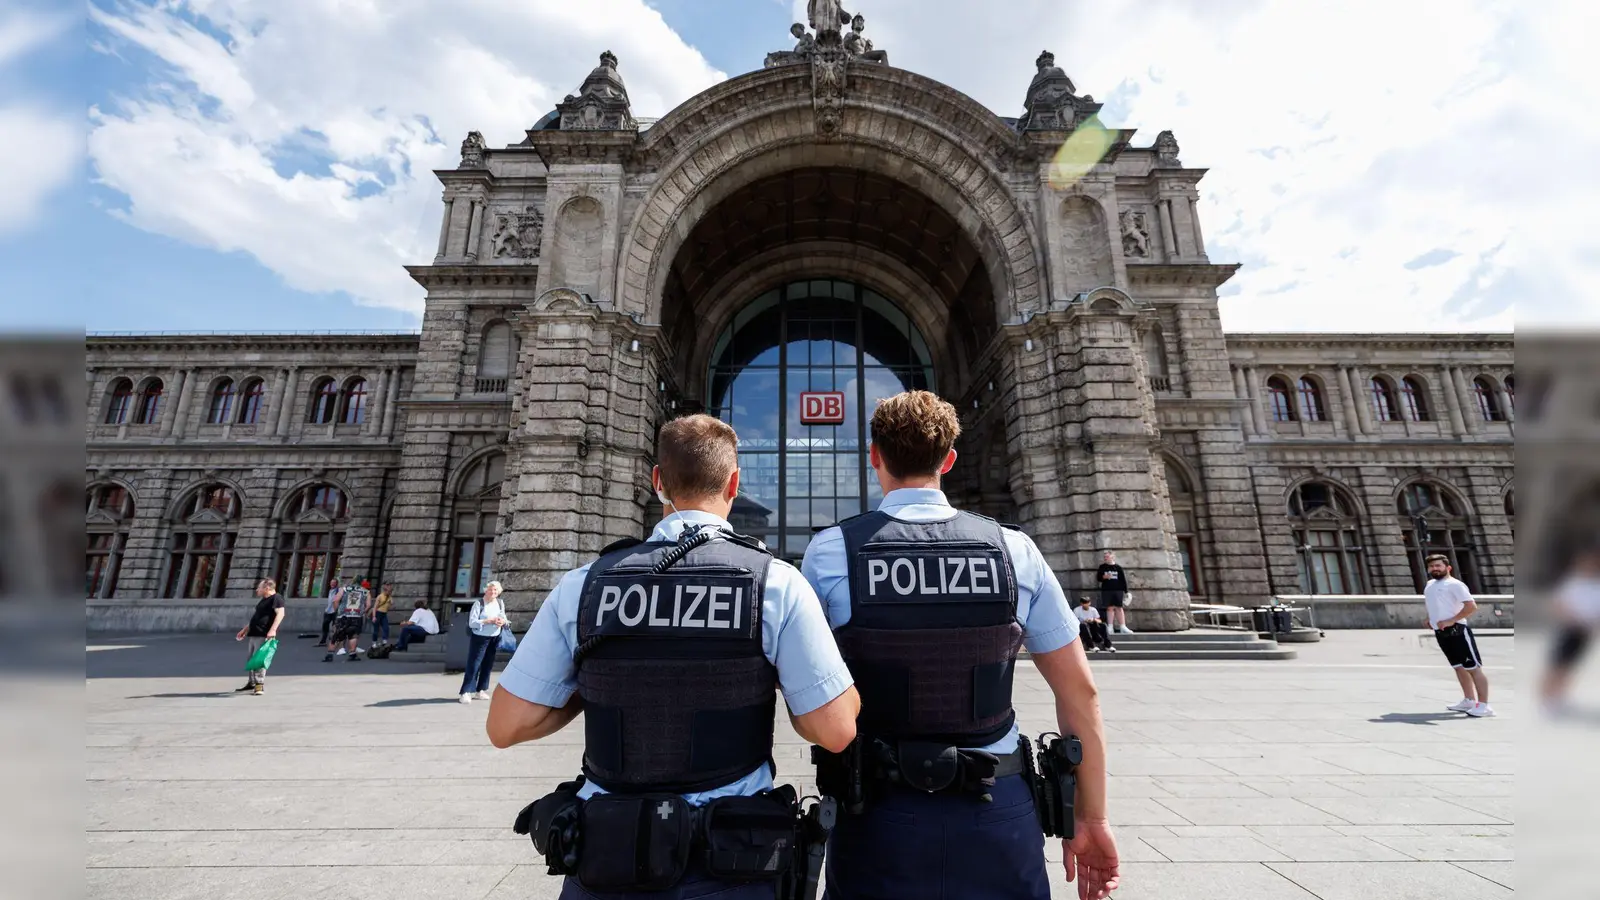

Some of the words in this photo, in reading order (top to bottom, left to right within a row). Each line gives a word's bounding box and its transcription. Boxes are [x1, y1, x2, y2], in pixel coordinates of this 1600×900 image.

[806, 397, 840, 417] DB
[868, 557, 1000, 596] POLIZEI
[595, 583, 743, 629] POLIZEI
